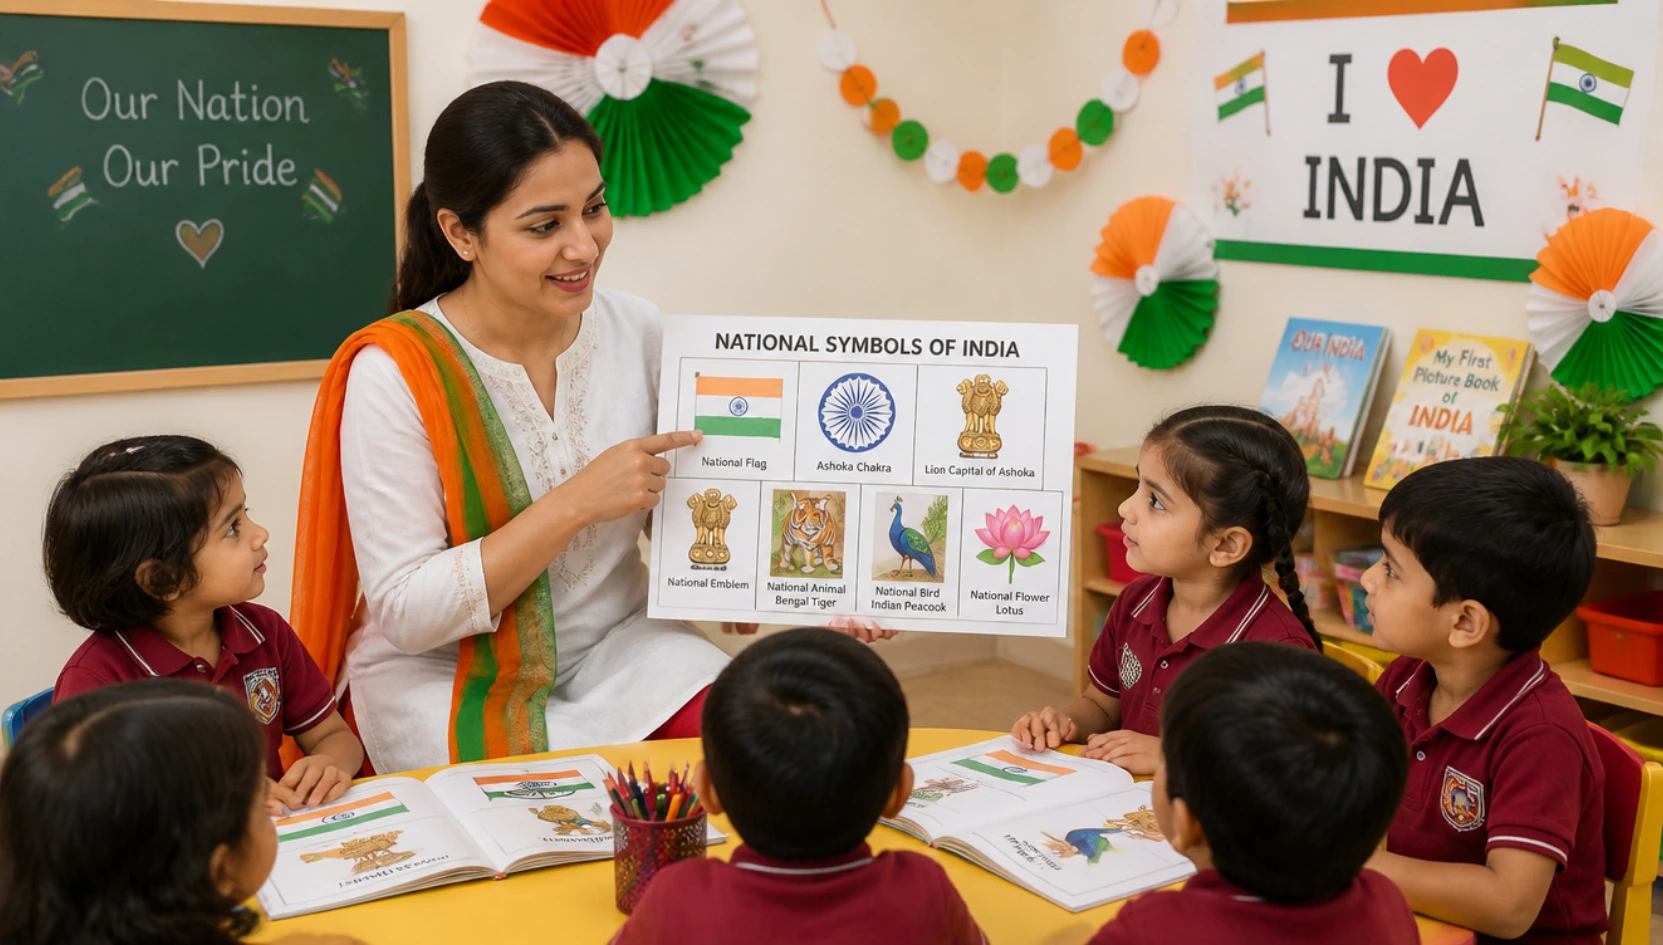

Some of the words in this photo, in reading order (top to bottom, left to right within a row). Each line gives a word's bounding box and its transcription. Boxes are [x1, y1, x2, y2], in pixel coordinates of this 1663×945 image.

[1327, 53, 1352, 124] I
[82, 77, 158, 121] Our
[177, 79, 311, 124] Nation
[103, 144, 179, 188] Our
[198, 143, 299, 187] Pride
[1303, 155, 1485, 227] INDIA
[715, 333, 819, 353] NATIONAL
[825, 337, 922, 355] SYMBOLS
[929, 339, 956, 357] OF
[962, 340, 1020, 358] INDIA
[1433, 349, 1455, 369] My
[1458, 349, 1493, 369] First
[1413, 366, 1461, 388] Picture
[1464, 372, 1501, 392] Book
[1442, 391, 1458, 404] of
[1408, 404, 1472, 436] INDIA
[701, 456, 743, 467] National
[746, 458, 767, 470] Flag
[816, 460, 854, 472] Ashoka
[857, 462, 892, 473] Chakra
[924, 464, 946, 475] Lion
[948, 465, 983, 478] Capital
[986, 466, 996, 476] of
[999, 468, 1035, 478] Ashoka
[667, 577, 708, 588] National
[710, 579, 750, 590] Emblem
[766, 581, 808, 593] National
[811, 583, 846, 595] Animal
[875, 586, 917, 598] National
[920, 588, 940, 598] Bird
[970, 590, 1013, 601] National
[1015, 592, 1050, 603] Flower
[775, 595, 809, 608] Bengal
[811, 597, 837, 609] Tiger
[871, 600, 902, 611] Indian
[995, 605, 1024, 616] Lotus
